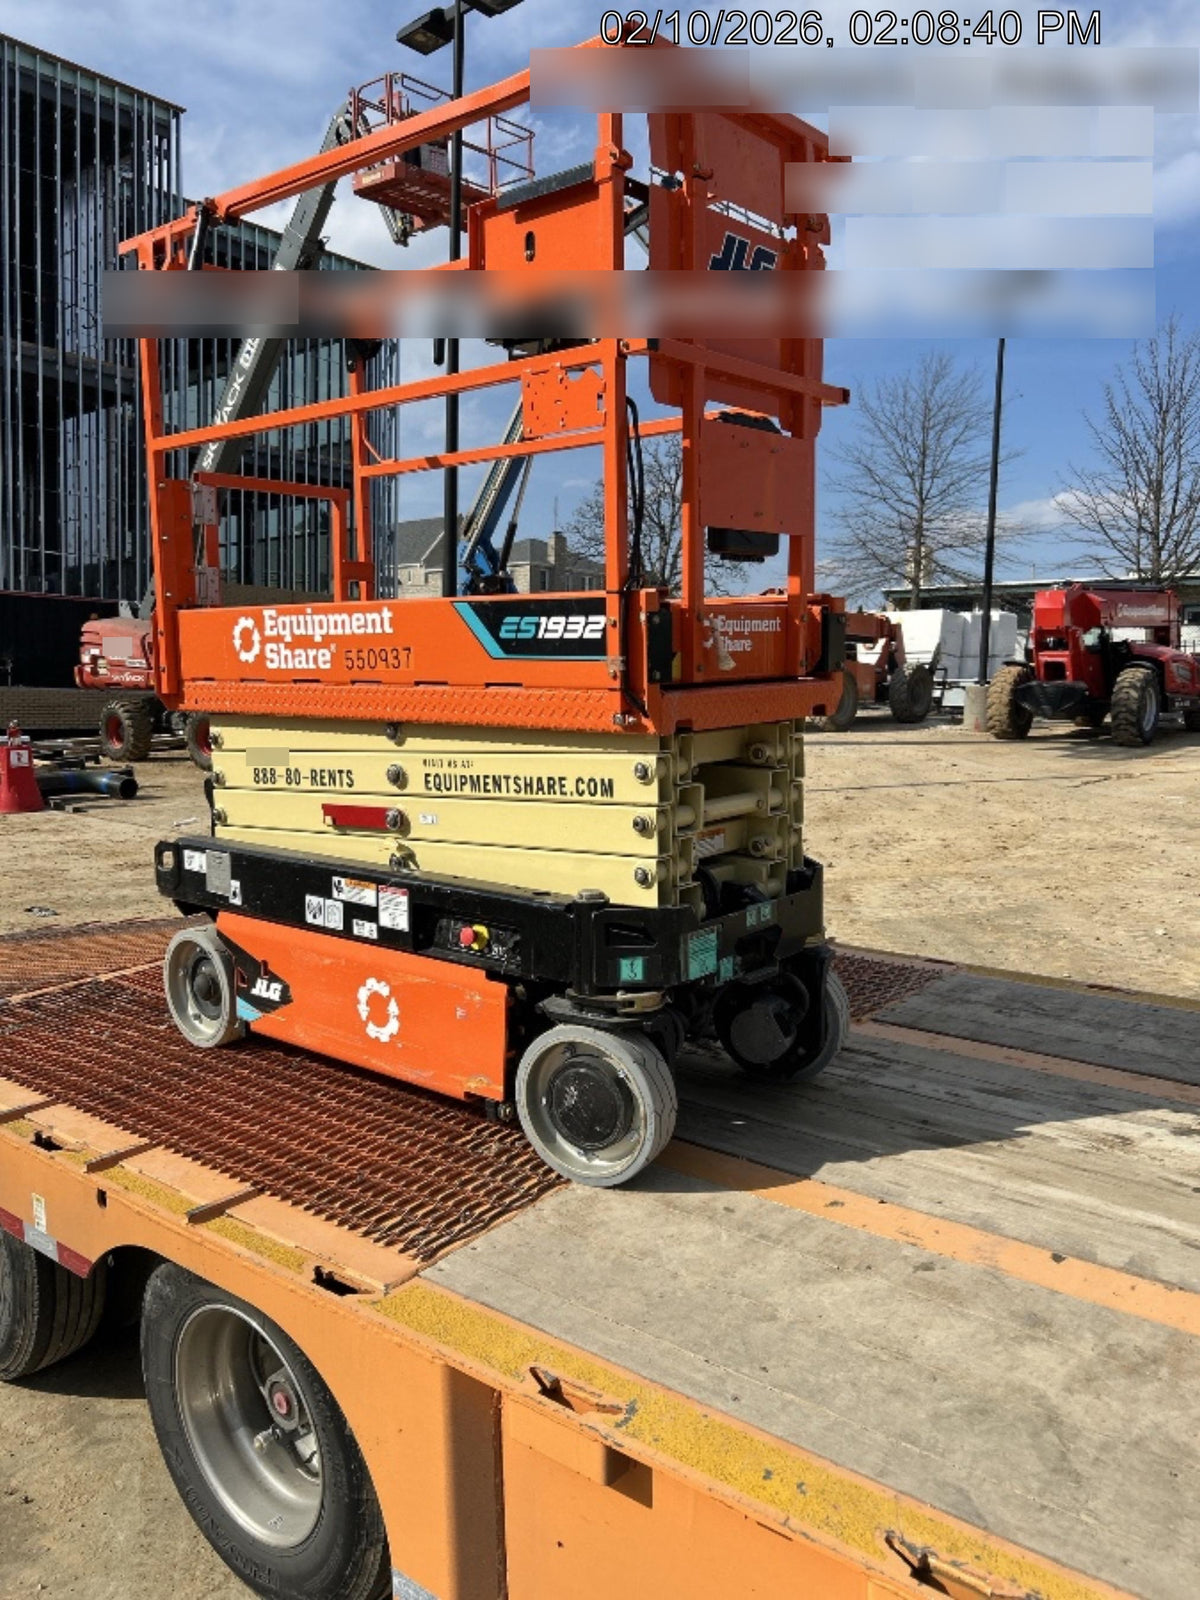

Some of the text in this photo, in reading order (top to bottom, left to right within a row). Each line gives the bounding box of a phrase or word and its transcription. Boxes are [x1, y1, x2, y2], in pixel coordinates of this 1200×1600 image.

[262, 606, 394, 642] Equipment
[499, 614, 606, 639] ES1932
[717, 615, 782, 635] Equipment
[344, 647, 412, 671] 550937
[253, 767, 355, 789] 888-80-RENTS
[424, 773, 615, 798] EQUIPMENTSHARE.COM
[250, 977, 283, 1002] JLG
